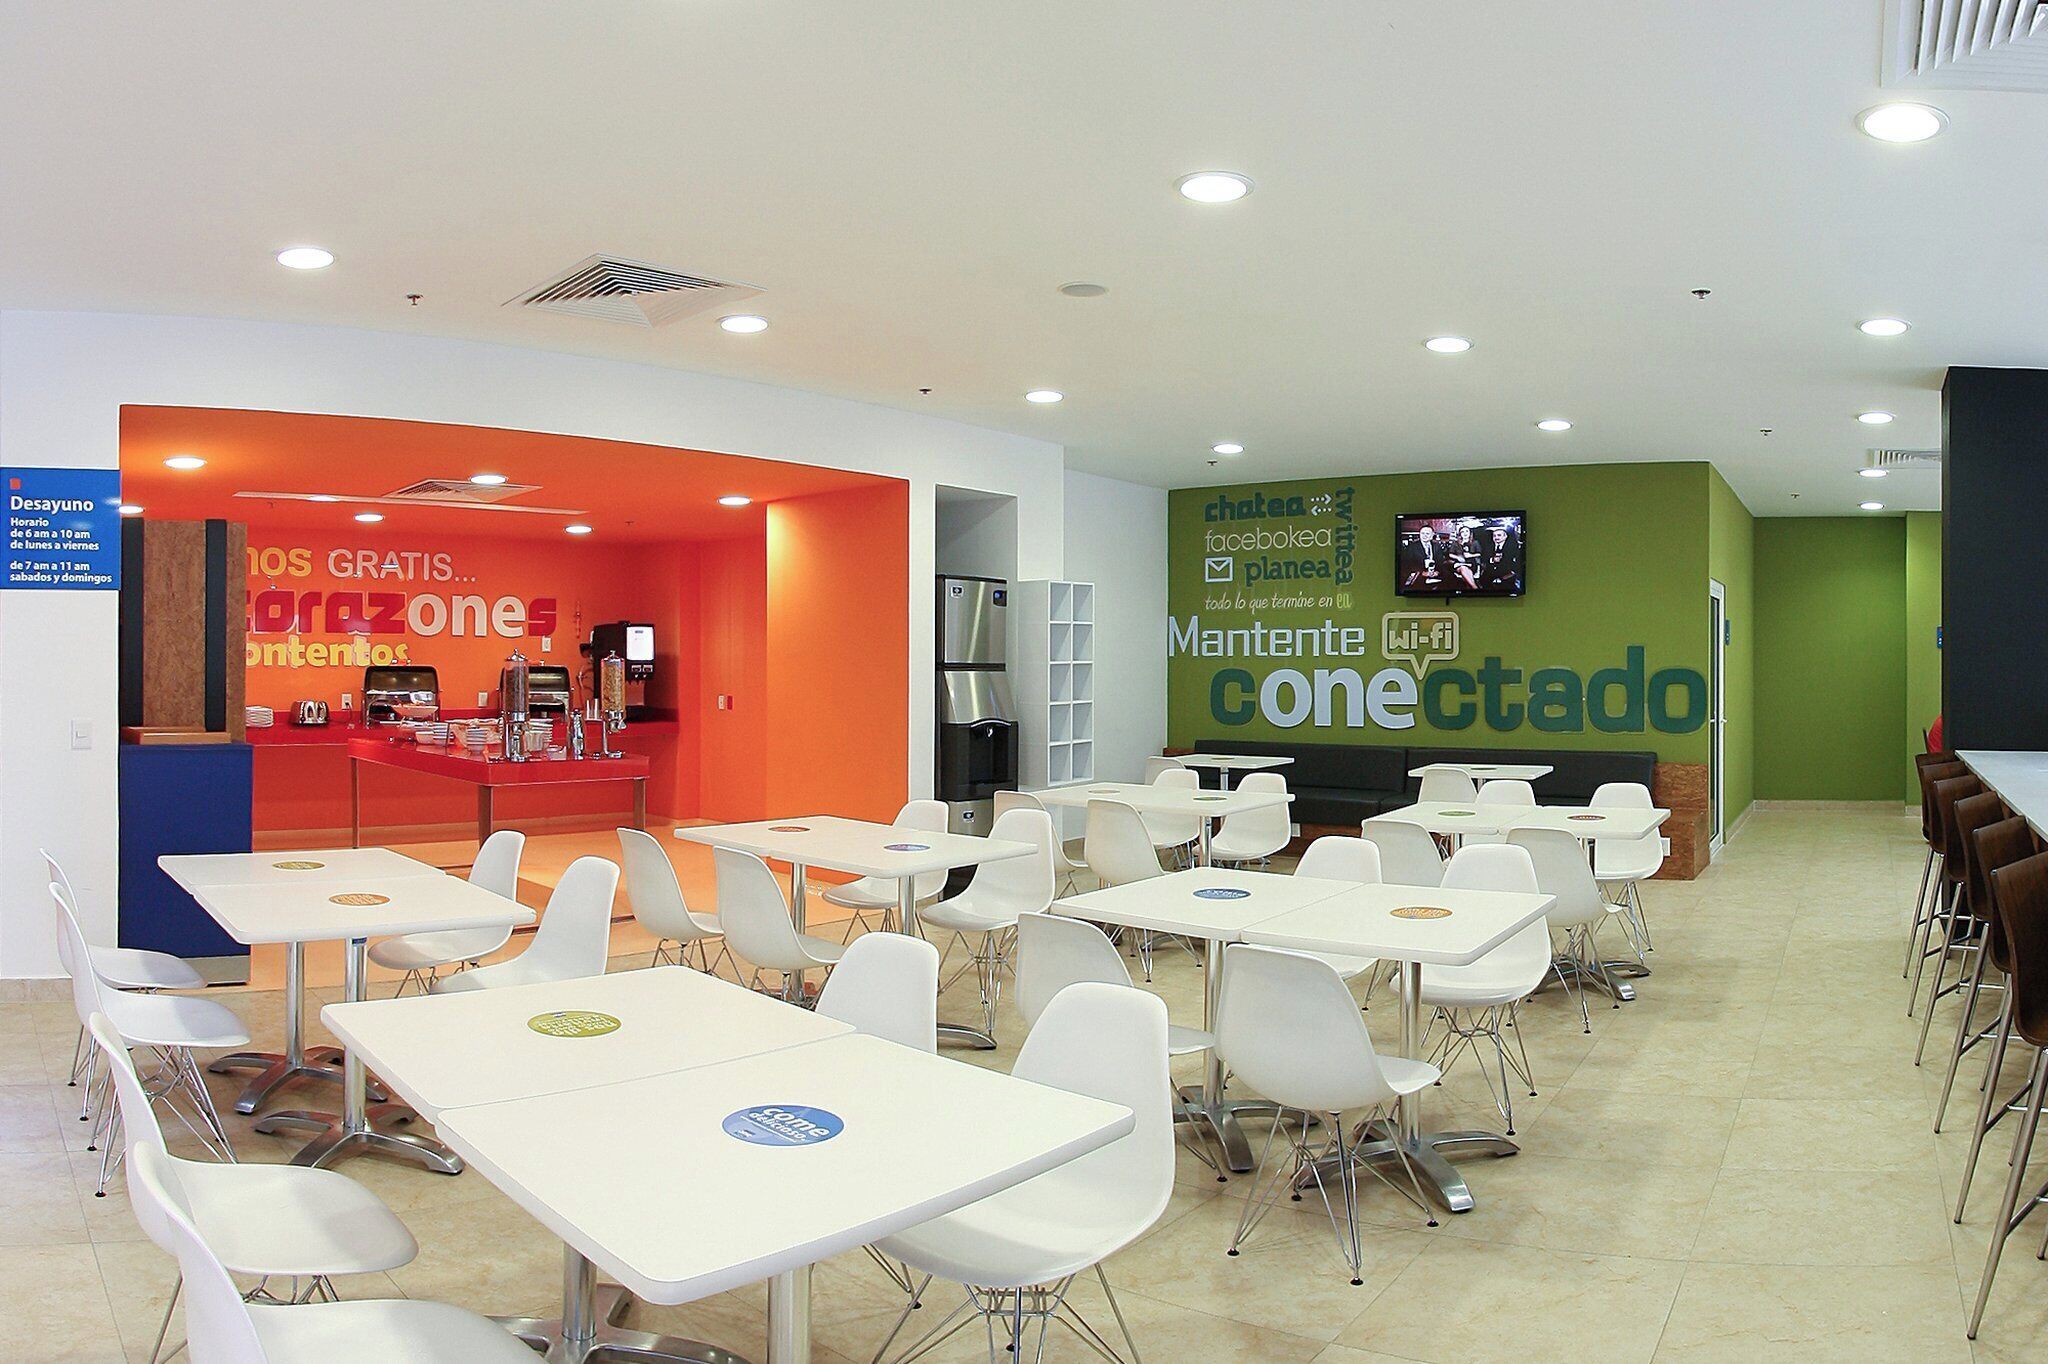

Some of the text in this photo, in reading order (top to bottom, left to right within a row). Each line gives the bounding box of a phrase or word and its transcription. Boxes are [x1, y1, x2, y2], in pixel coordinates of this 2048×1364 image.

[10, 495, 94, 514] Desayuno
[1205, 492, 1306, 522] chatea
[10, 517, 50, 527] Horario
[10, 529, 24, 538] de
[25, 529, 33, 538] 6
[51, 531, 58, 539] a
[60, 530, 73, 538] 10
[74, 531, 91, 539] am
[1335, 486, 1359, 586] twittea
[10, 540, 100, 551] de lunes a viernes
[1206, 525, 1332, 552] facebokea
[10, 561, 90, 571] de 7 am a 11 am
[10, 573, 113, 584] sabados y domingos
[328, 549, 476, 583] GRATIS...
[1244, 556, 1331, 587] planea
[246, 589, 557, 637] orazones
[1205, 592, 1231, 610] todo
[1234, 591, 1246, 609] lo
[1249, 598, 1269, 615] que
[1271, 591, 1315, 609] termine
[1318, 596, 1333, 608] en
[1168, 615, 1366, 658] Mantente
[1389, 622, 1453, 650] wi-fi
[1209, 645, 1709, 733] conectado
[763, 1108, 830, 1137] come
